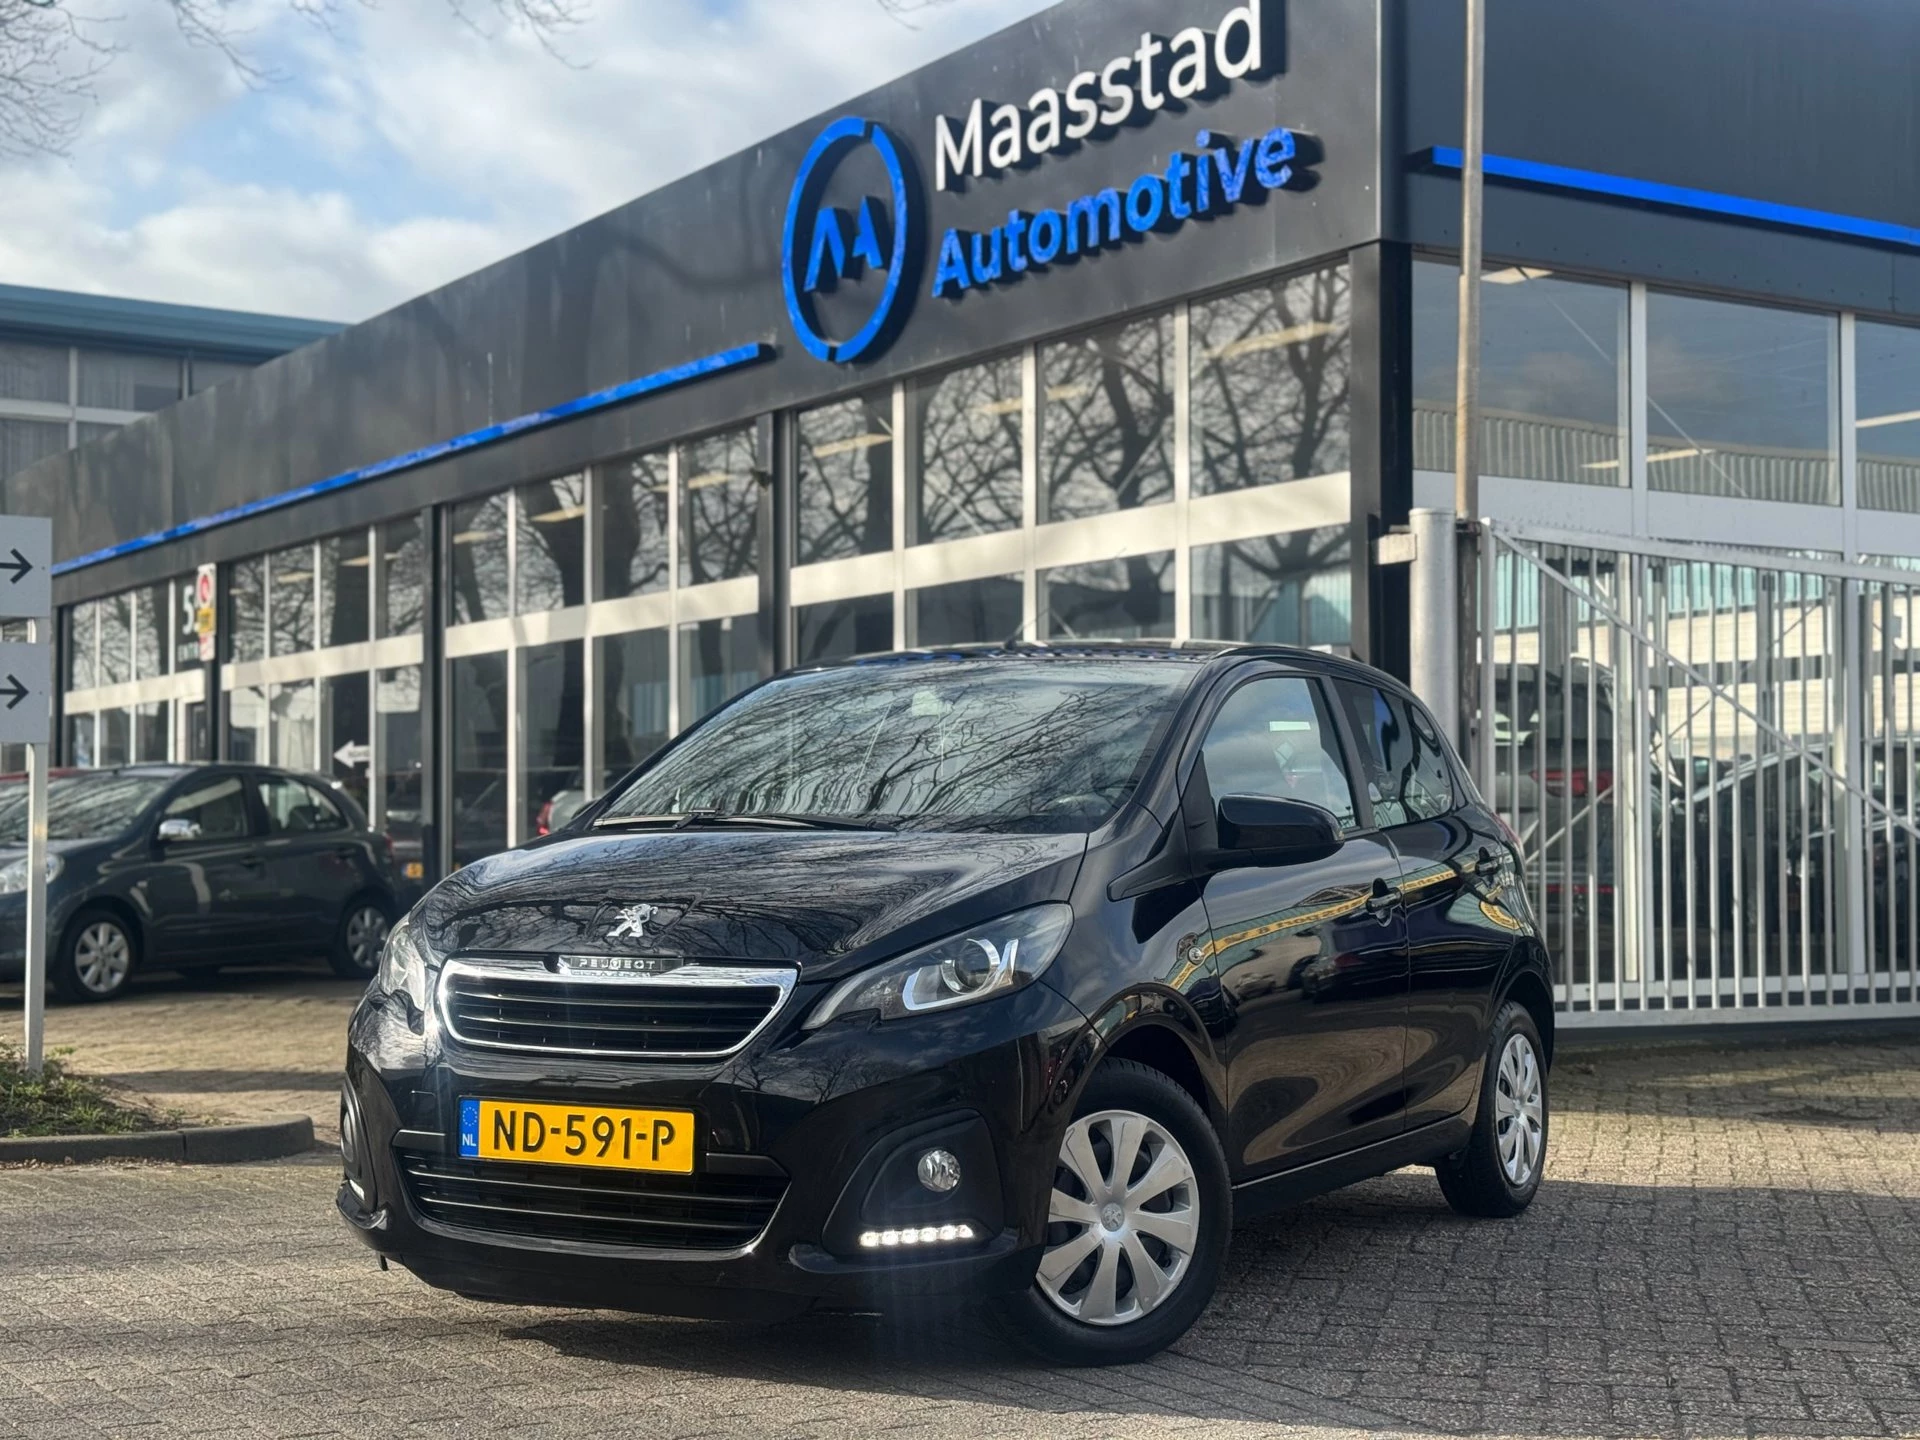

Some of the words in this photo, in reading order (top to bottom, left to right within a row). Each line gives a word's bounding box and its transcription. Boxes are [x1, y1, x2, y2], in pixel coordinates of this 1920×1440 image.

[934, 0, 1262, 191] Maasstad
[931, 126, 1297, 298] Automotive
[578, 957, 656, 970] PEUGEOT
[462, 1134, 477, 1147] NL
[493, 1109, 676, 1161] ND-591-P
